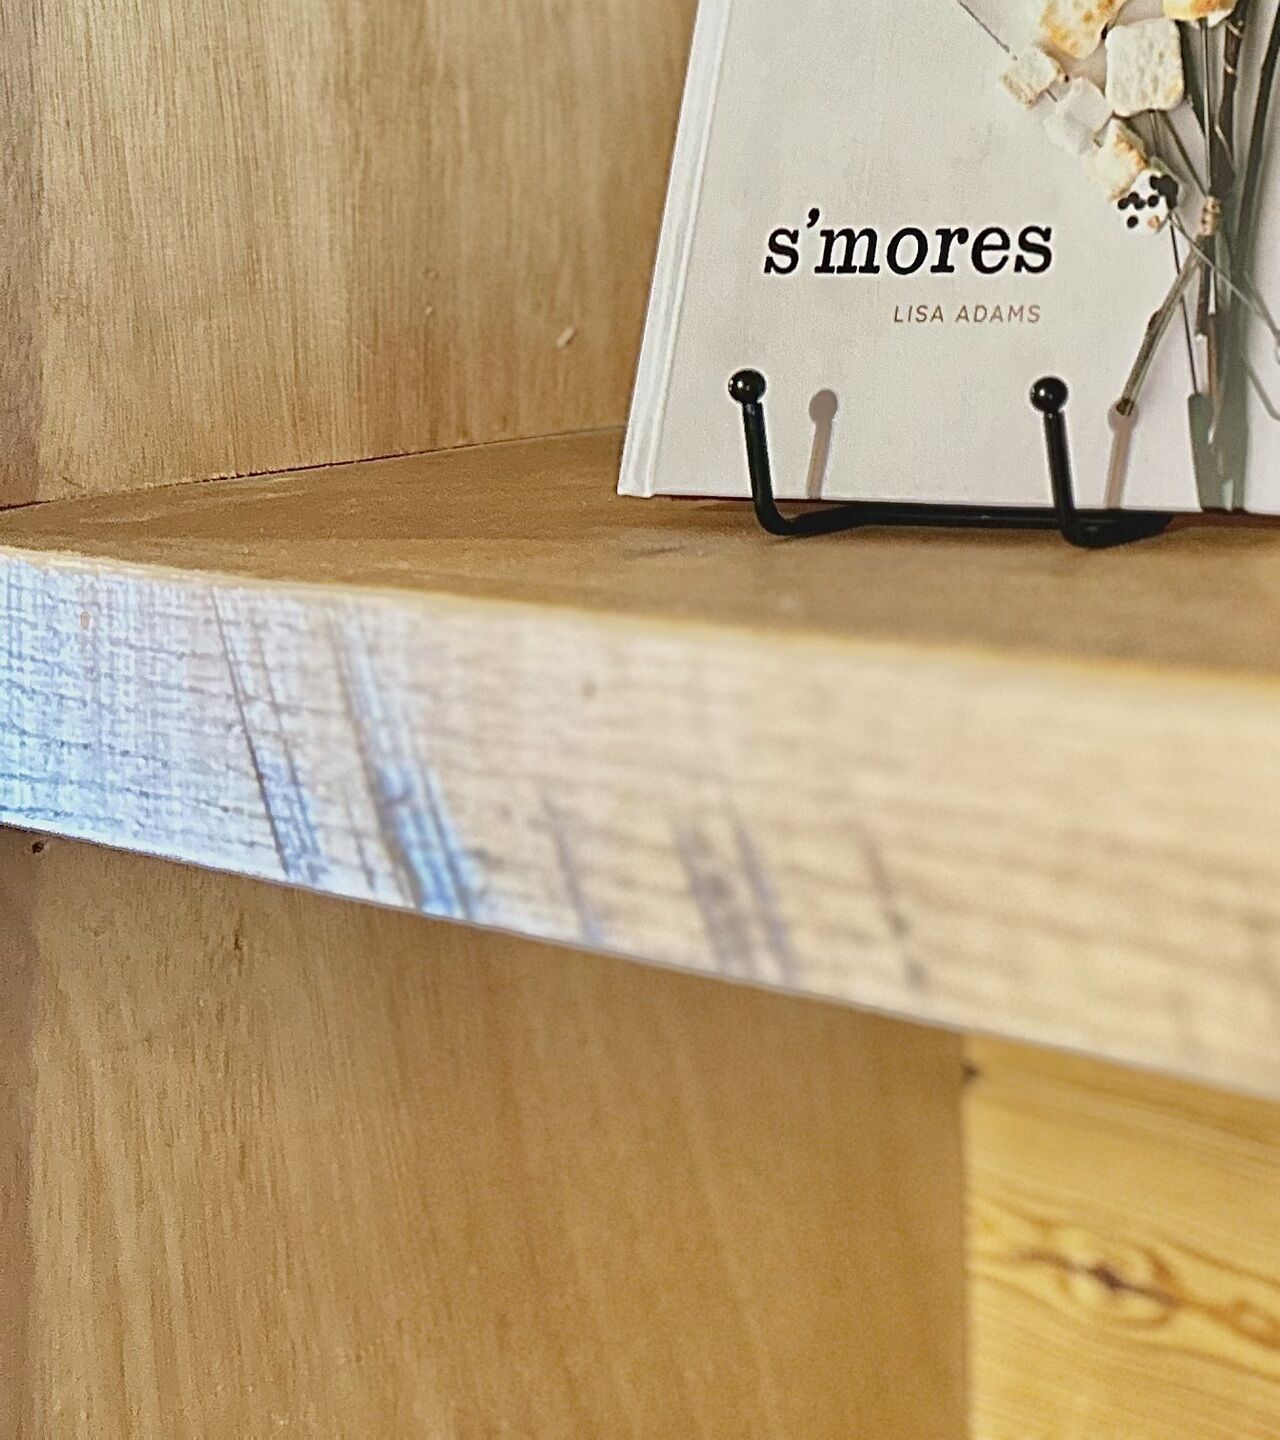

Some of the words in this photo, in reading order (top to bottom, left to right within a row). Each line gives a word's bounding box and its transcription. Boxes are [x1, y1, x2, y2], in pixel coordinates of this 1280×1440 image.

[763, 207, 1053, 275] s'mores
[893, 305, 944, 323] LISA
[955, 305, 1041, 323] ADAMS
